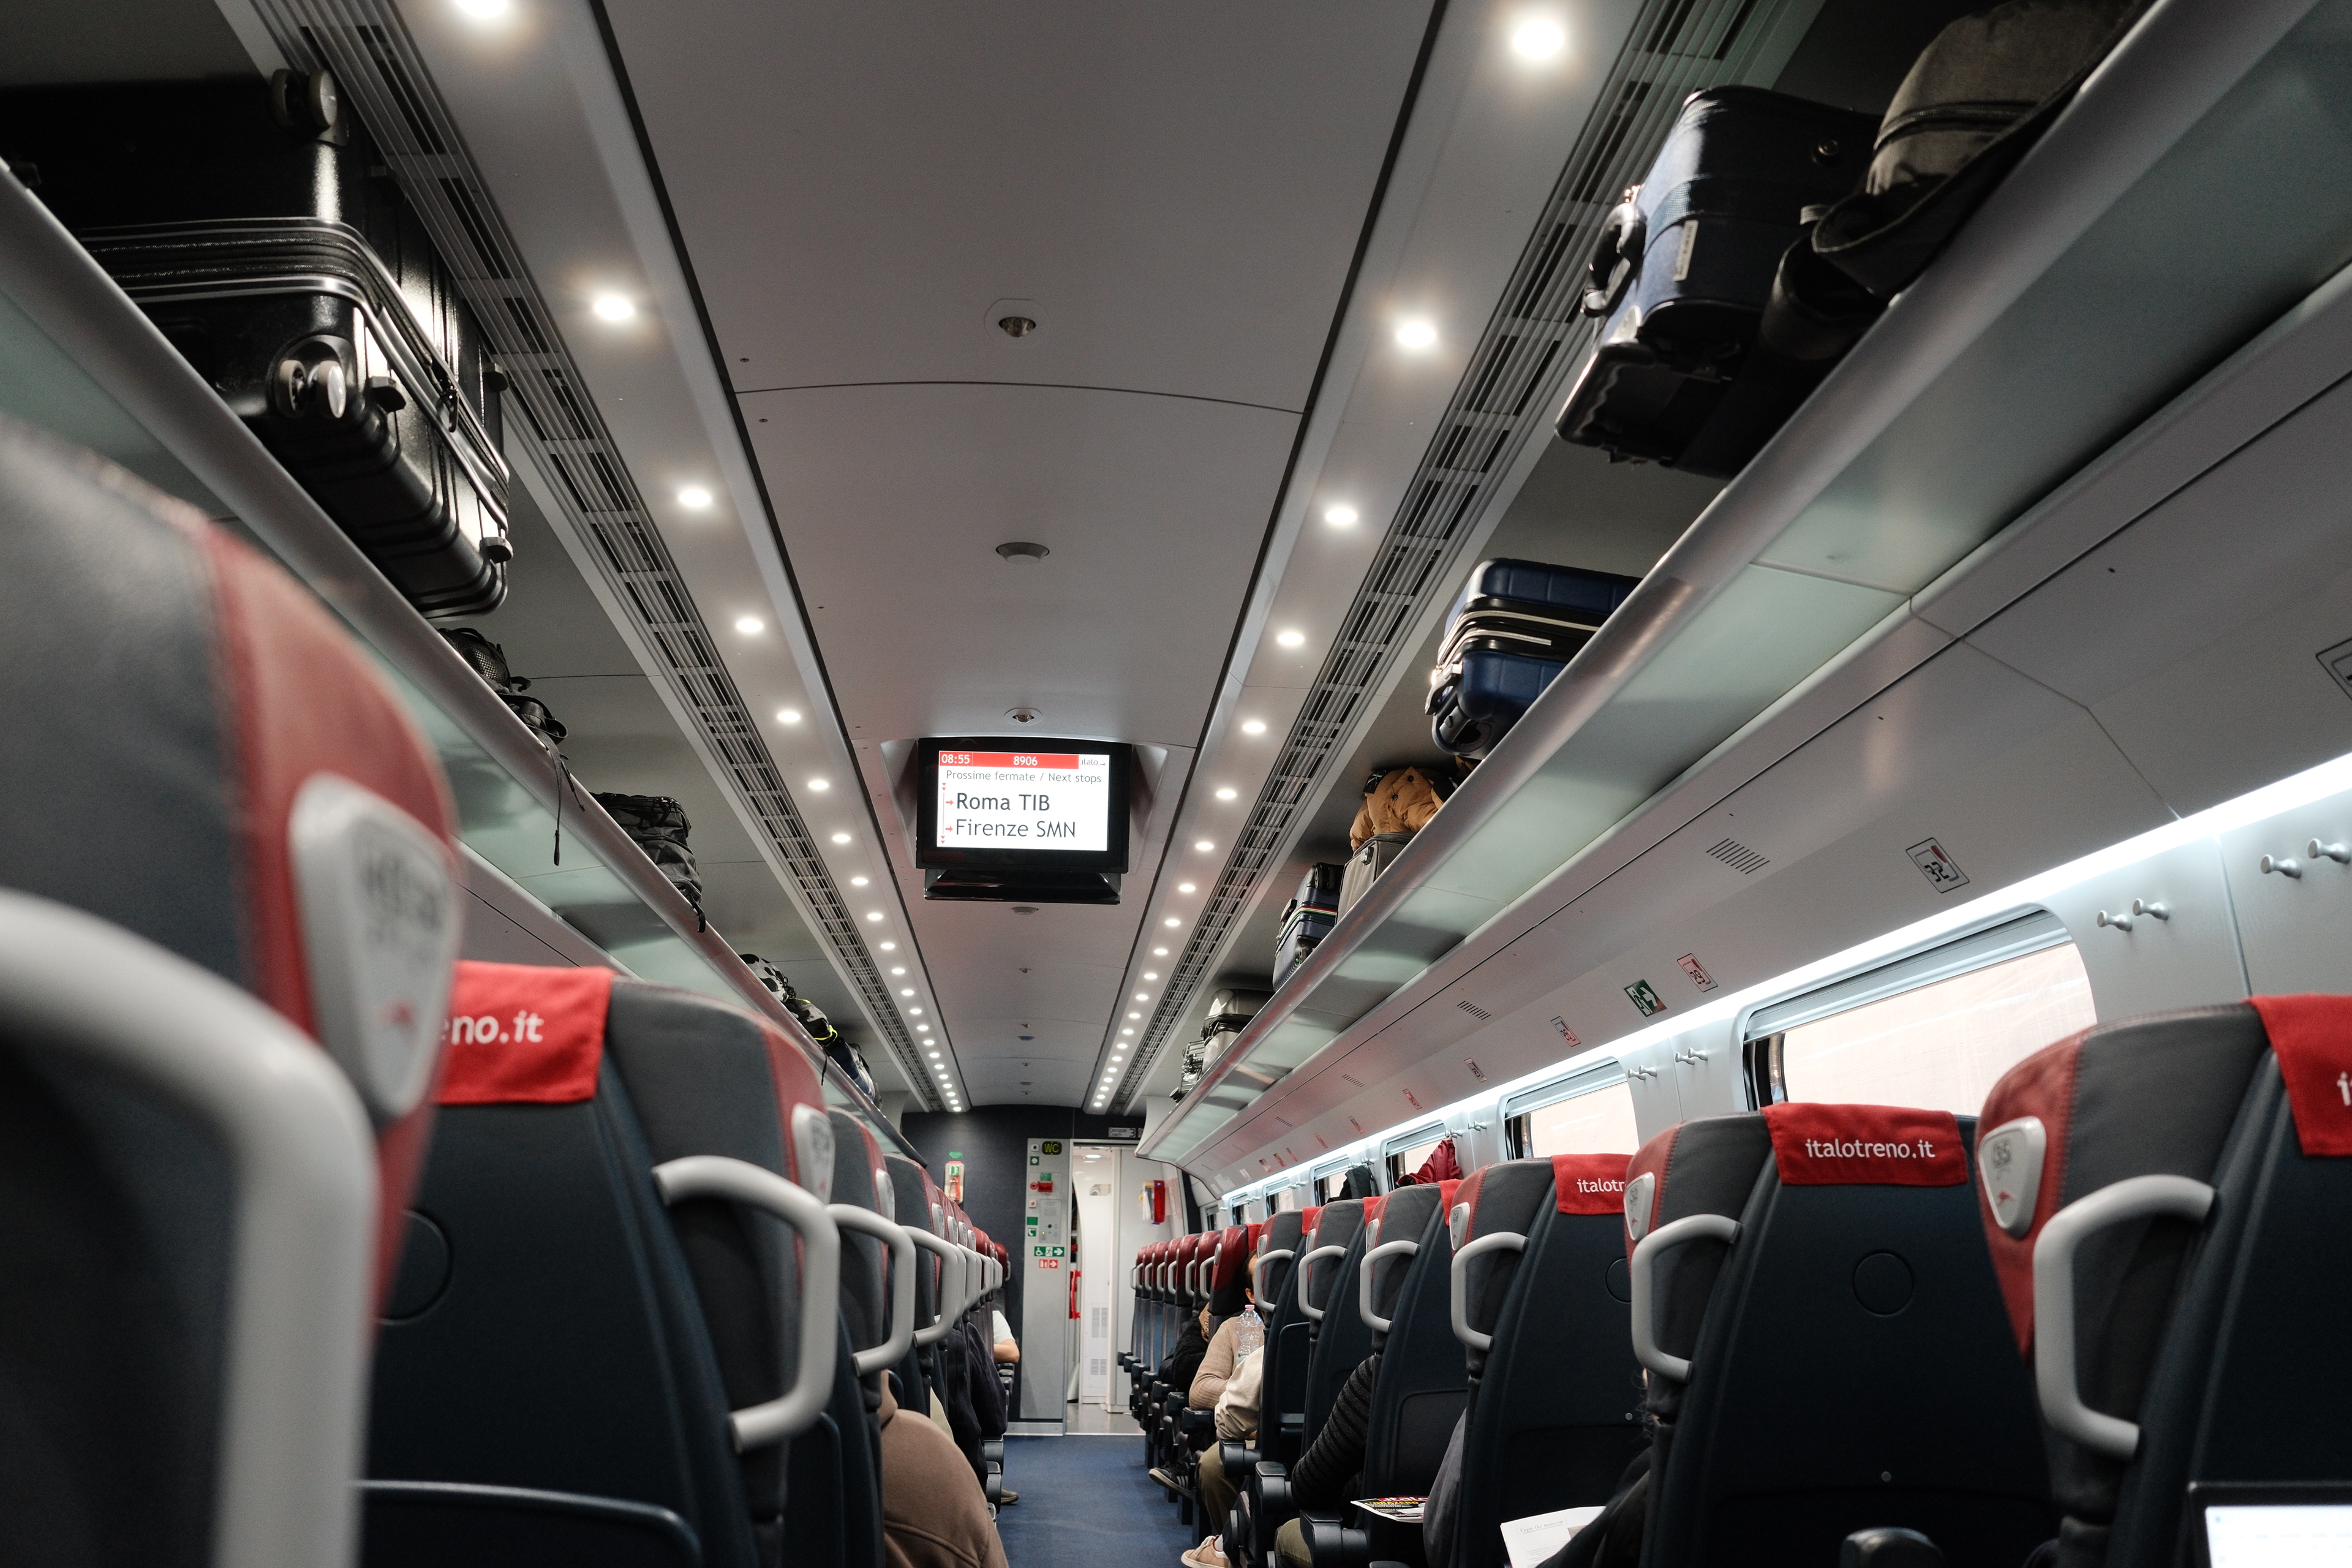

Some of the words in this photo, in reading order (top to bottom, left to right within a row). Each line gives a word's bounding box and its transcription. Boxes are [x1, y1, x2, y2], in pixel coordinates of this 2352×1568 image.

[941, 754, 970, 764] 08:55
[1013, 756, 1038, 766] 8906
[946, 770, 991, 780] Prossime
[995, 771, 1036, 781] fermate
[1040, 772, 1044, 781] /
[1049, 773, 1072, 782] Next
[1076, 774, 1101, 784] stops
[957, 793, 1011, 810] Roma
[1019, 794, 1050, 811] TIB
[956, 819, 1028, 837] Firenze
[1036, 821, 1076, 838] SMN
[1924, 861, 1950, 883] 32
[1690, 970, 1705, 985] 29
[1129, 1128, 1135, 1137] 3
[1044, 1144, 1059, 1153] WC
[1805, 1138, 1936, 1159] italotreno.it
[1577, 1177, 1627, 1193] italotr
